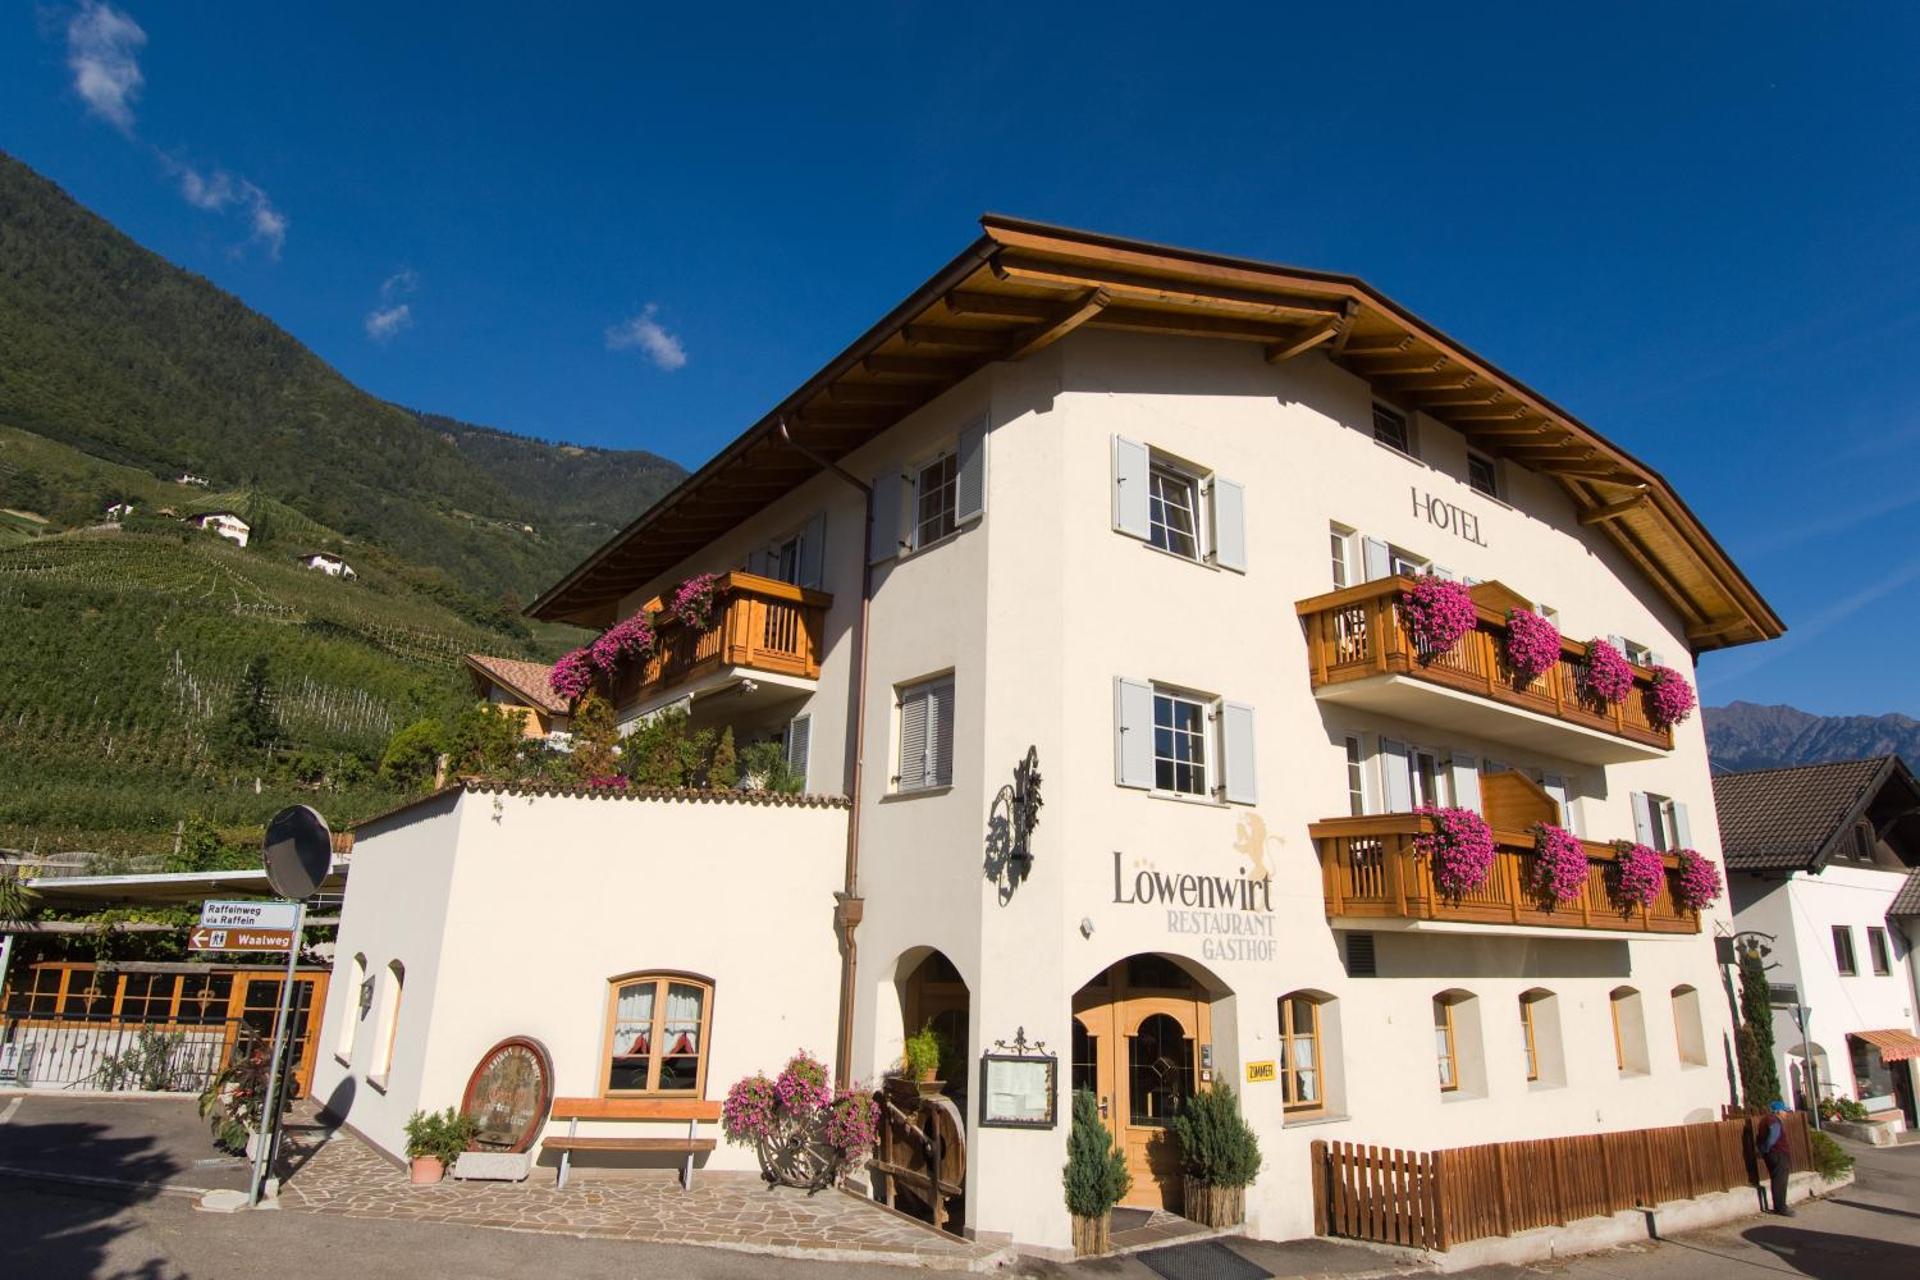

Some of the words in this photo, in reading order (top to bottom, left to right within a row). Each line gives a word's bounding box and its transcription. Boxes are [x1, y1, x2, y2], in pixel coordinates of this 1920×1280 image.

[1411, 486, 1487, 547] HOTEL
[208, 904, 262, 916] Raffeinweg
[220, 915, 255, 925] Raffein
[1167, 910, 1275, 936] RESTAURANT
[238, 934, 290, 947] Waalweg
[1202, 938, 1277, 961] GASTHOF
[1249, 1064, 1273, 1078] ZIMMER
